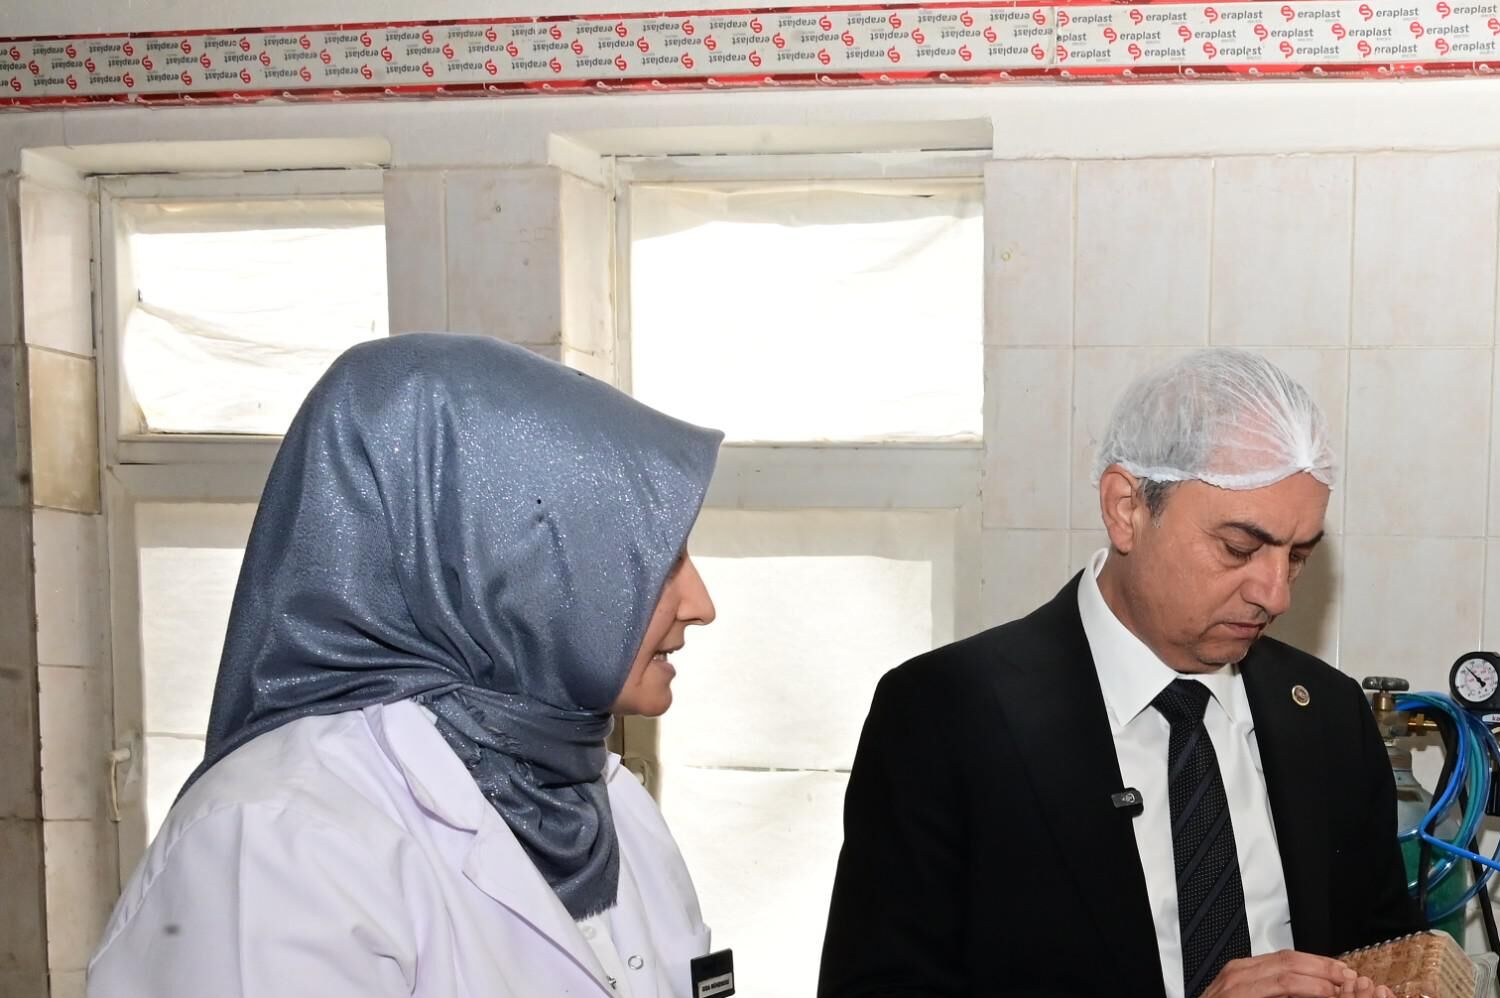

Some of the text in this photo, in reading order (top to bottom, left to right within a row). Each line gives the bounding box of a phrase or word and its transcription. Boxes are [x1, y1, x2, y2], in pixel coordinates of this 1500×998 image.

[1221, 10, 1262, 20] eraplast
[1298, 10, 1340, 19] eraplast
[1376, 8, 1418, 18] eraplast
[1453, 5, 1497, 15] eraplast
[848, 16, 886, 26] eraplast
[918, 14, 957, 23] eraplast
[990, 12, 1030, 21] eraplast
[1072, 14, 1112, 24] eraplast
[1146, 12, 1187, 22] eraplast
[643, 23, 679, 32] eraplast
[710, 20, 747, 30] eraplast
[779, 18, 816, 28] eraplast
[576, 25, 613, 34] eraplast
[941, 29, 981, 39] eraplast
[1271, 28, 1313, 39] eraplast
[1349, 27, 1391, 38] eraplast
[1426, 24, 1469, 36] eraplast
[732, 35, 770, 45] eraplast
[801, 33, 839, 43] eraplast
[870, 30, 909, 40] eraplast
[1120, 31, 1160, 41] eraplast
[1195, 30, 1236, 40] eraplast
[533, 42, 569, 51] eraplast
[598, 40, 634, 50] eraplast
[665, 37, 701, 47] eraplast
[1452, 41, 1495, 52] eraplast
[846, 49, 884, 60] eraplast
[917, 48, 956, 57] eraplast
[989, 46, 1028, 56] eraplast
[1071, 49, 1111, 59] eraplast
[1144, 48, 1185, 57] eraplast
[1296, 46, 1339, 56] eraplast
[642, 56, 678, 65] eraplast
[709, 54, 746, 63] eraplast
[778, 52, 815, 61] eraplast
[512, 60, 547, 70] eraplast
[576, 58, 612, 68] eraplast
